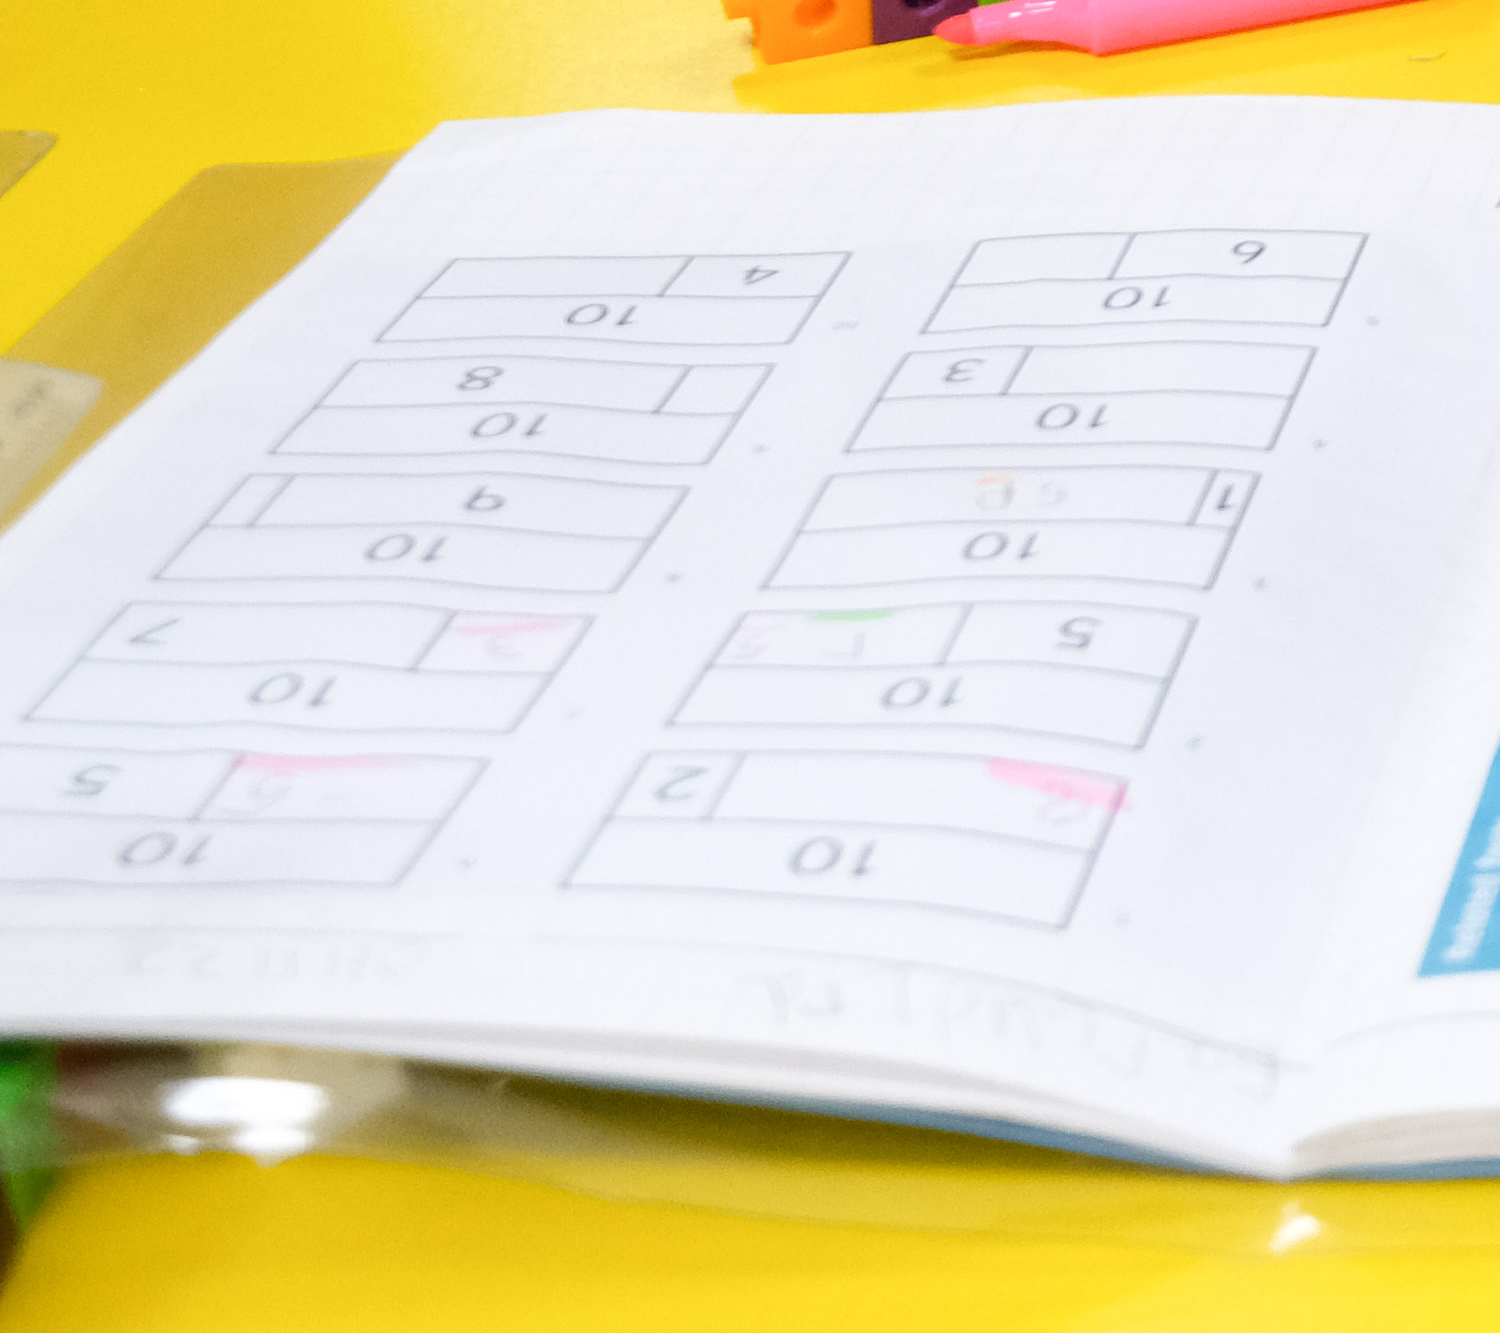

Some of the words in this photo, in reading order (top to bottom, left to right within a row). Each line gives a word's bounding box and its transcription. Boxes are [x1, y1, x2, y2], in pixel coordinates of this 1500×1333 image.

[1228, 239, 1267, 266] 6
[741, 265, 780, 287] 4
[1099, 283, 1172, 313] 10
[563, 303, 639, 328] 10
[455, 365, 504, 392] 8
[939, 357, 986, 386] 3
[469, 412, 550, 441] 10
[1032, 402, 1111, 432] 10
[462, 485, 508, 515] 9
[362, 533, 448, 565] 10
[960, 530, 1041, 564] 10
[128, 615, 181, 647] 7
[1053, 615, 1103, 653] 5
[247, 674, 339, 710] 10
[878, 675, 965, 711] 10
[61, 764, 123, 799] 5
[654, 764, 709, 804] 2
[116, 831, 214, 871] 10
[786, 835, 879, 880] 10
